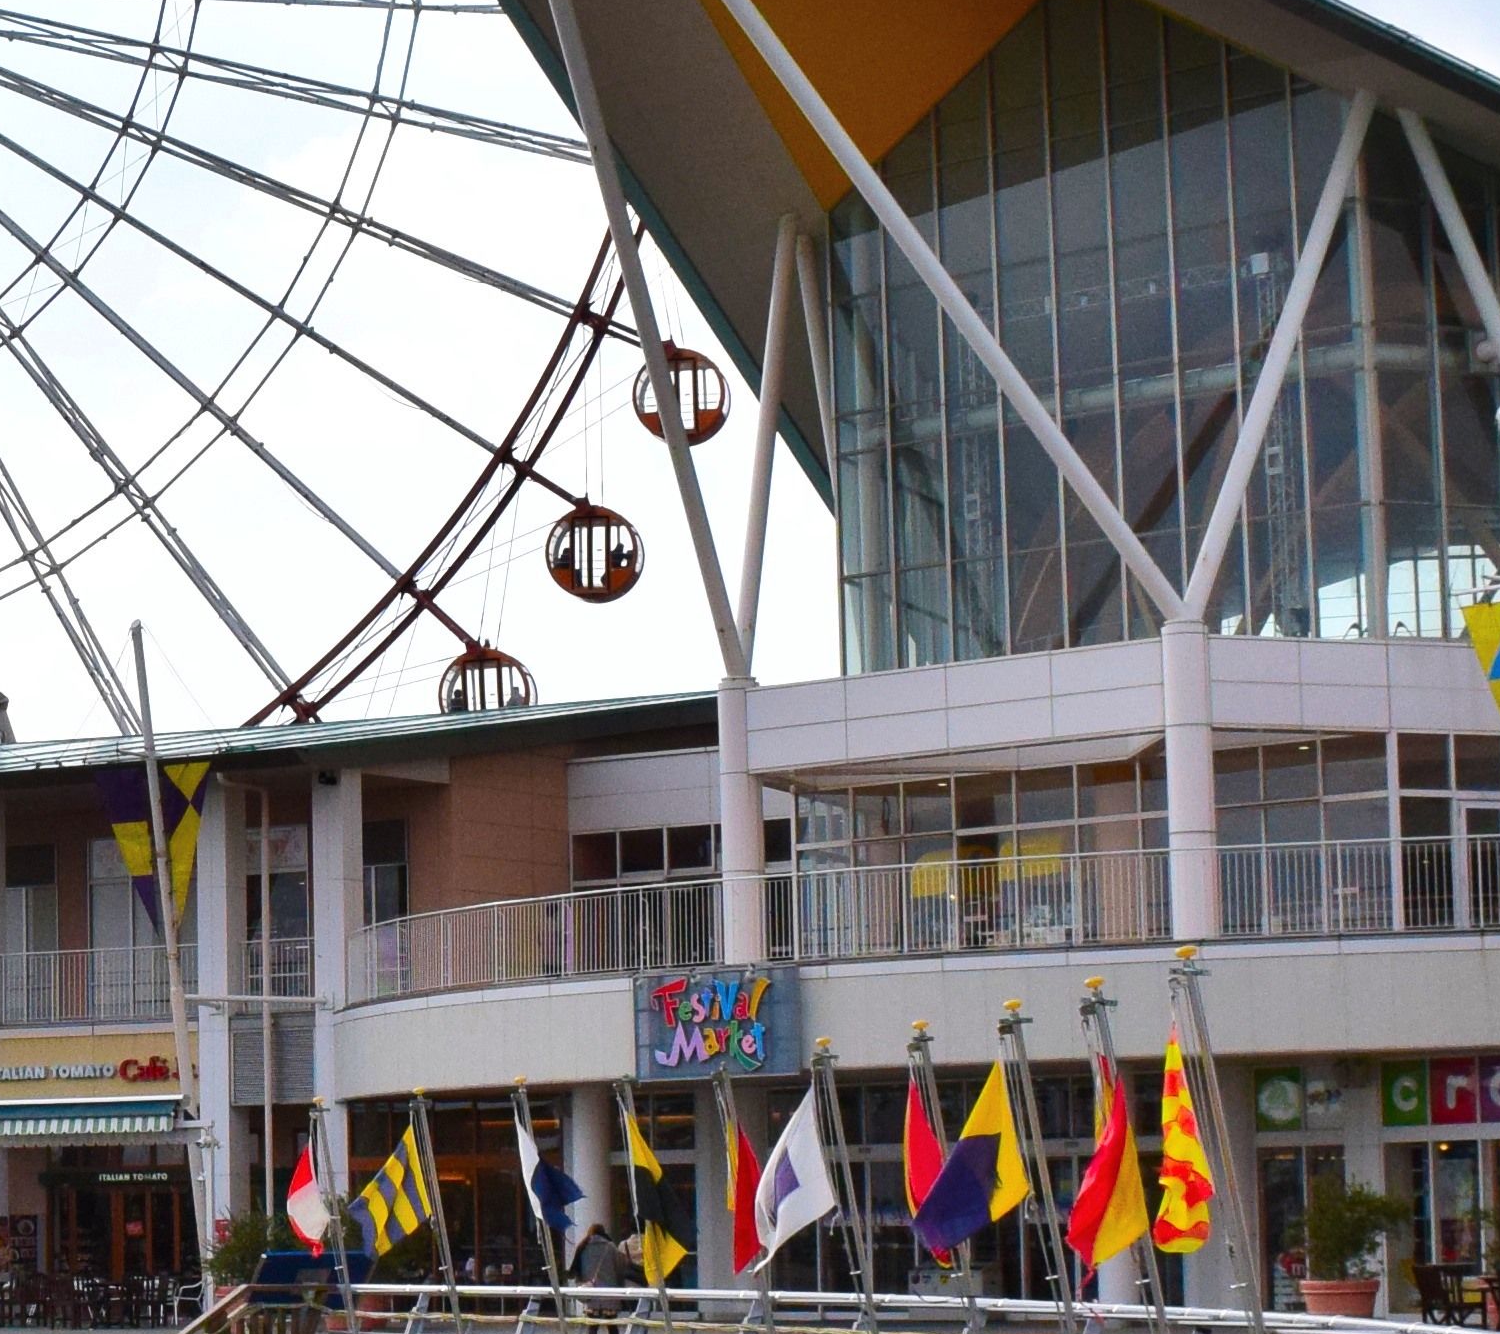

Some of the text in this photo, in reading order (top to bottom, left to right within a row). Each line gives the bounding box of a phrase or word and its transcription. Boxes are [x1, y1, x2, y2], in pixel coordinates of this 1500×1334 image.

[655, 1020, 765, 1071] Market
[50, 1064, 115, 1079] TOMATO
[99, 1172, 168, 1182] ITALIAN TOMATO
